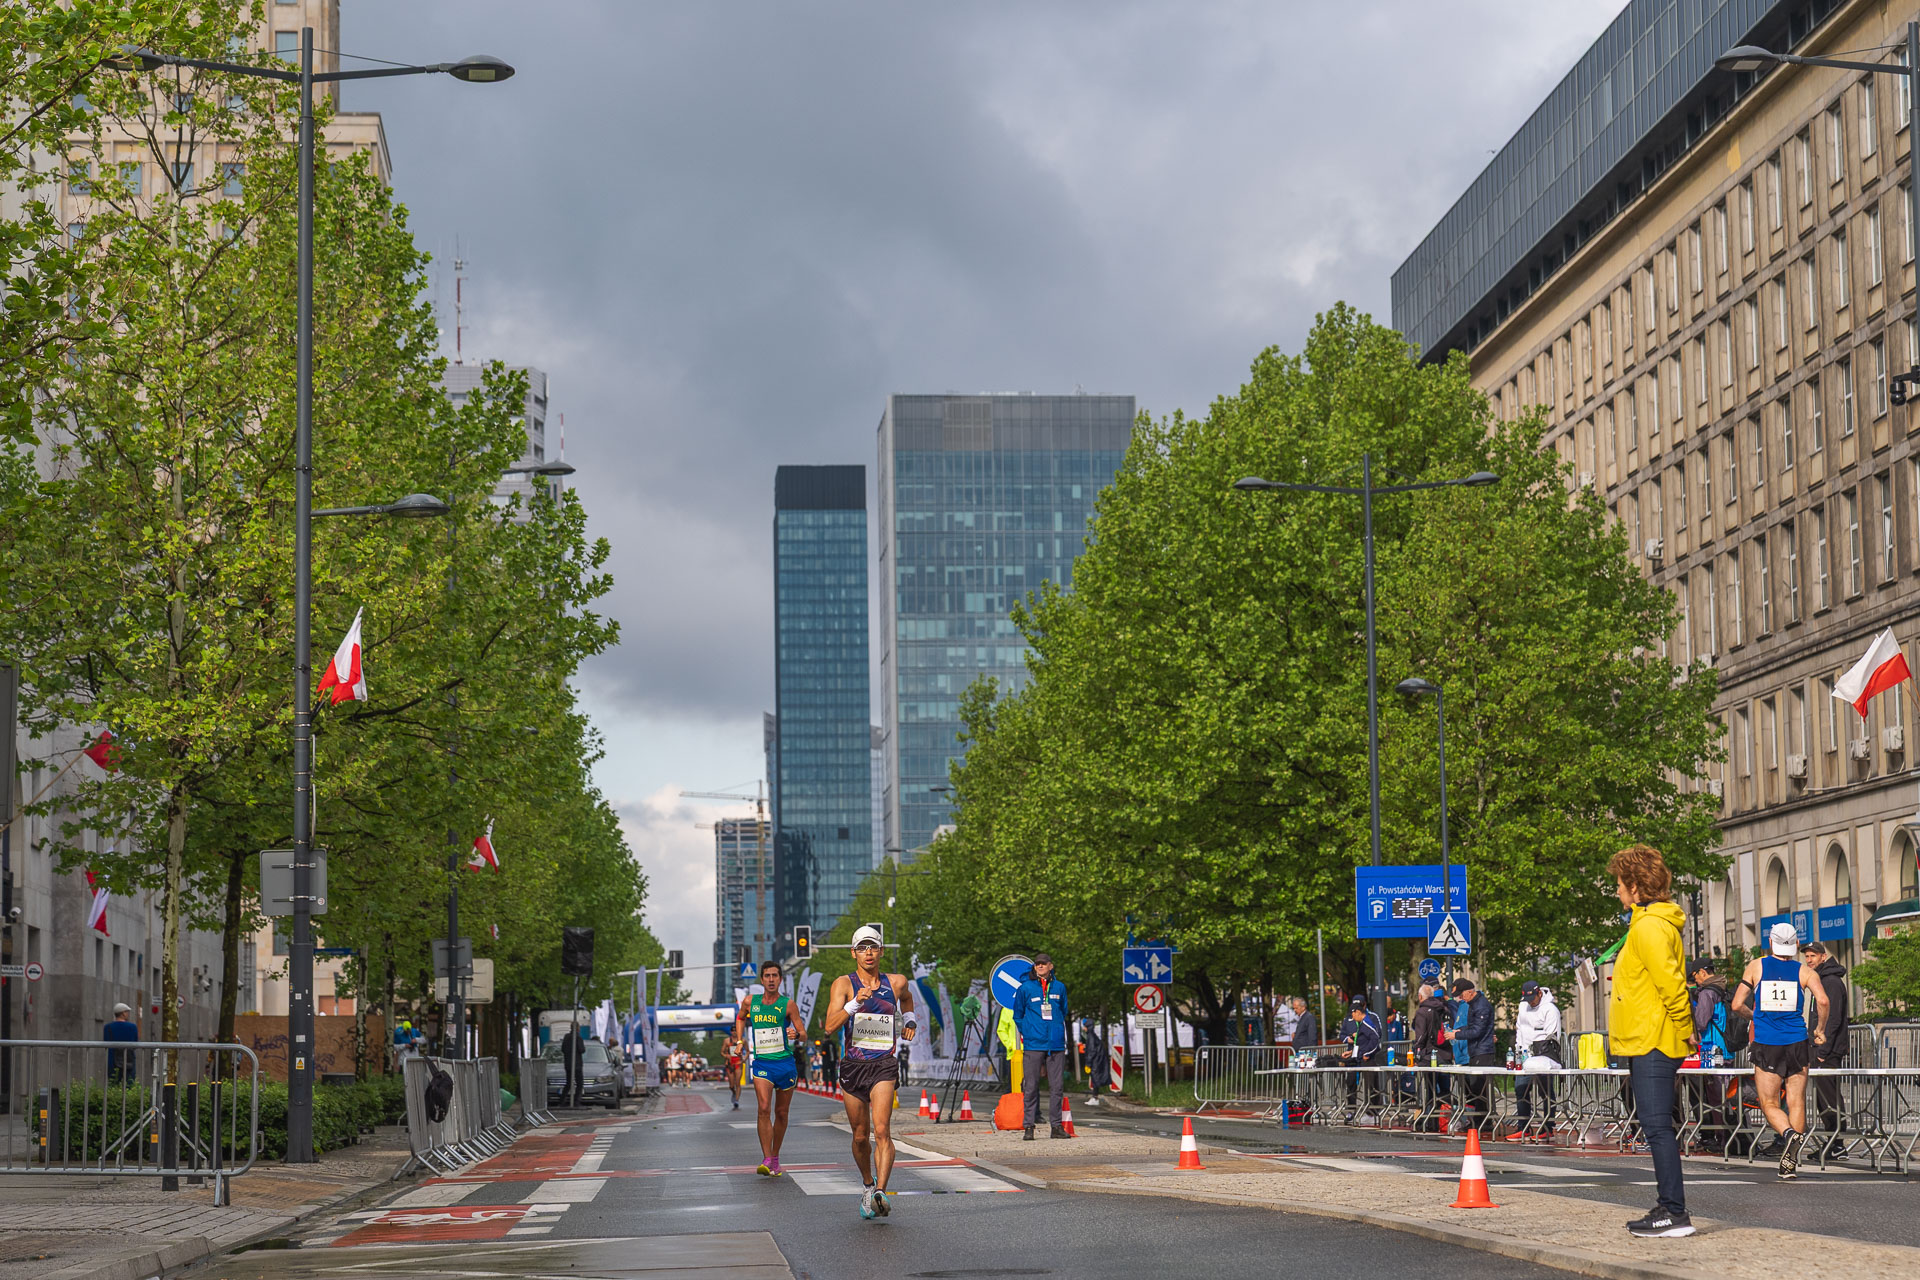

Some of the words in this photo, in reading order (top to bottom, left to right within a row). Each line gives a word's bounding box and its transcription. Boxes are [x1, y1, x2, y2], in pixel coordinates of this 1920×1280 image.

[1367, 886, 1376, 896] pl.
[1379, 885, 1423, 895] Powstańców
[1425, 884, 1460, 895] Warszwy
[1772, 989, 1787, 1001] 11
[754, 1014, 778, 1024] BRASIL
[879, 1015, 890, 1024] 43
[856, 1028, 890, 1037] YAMANISHI
[1652, 1218, 1673, 1229] HOKA
